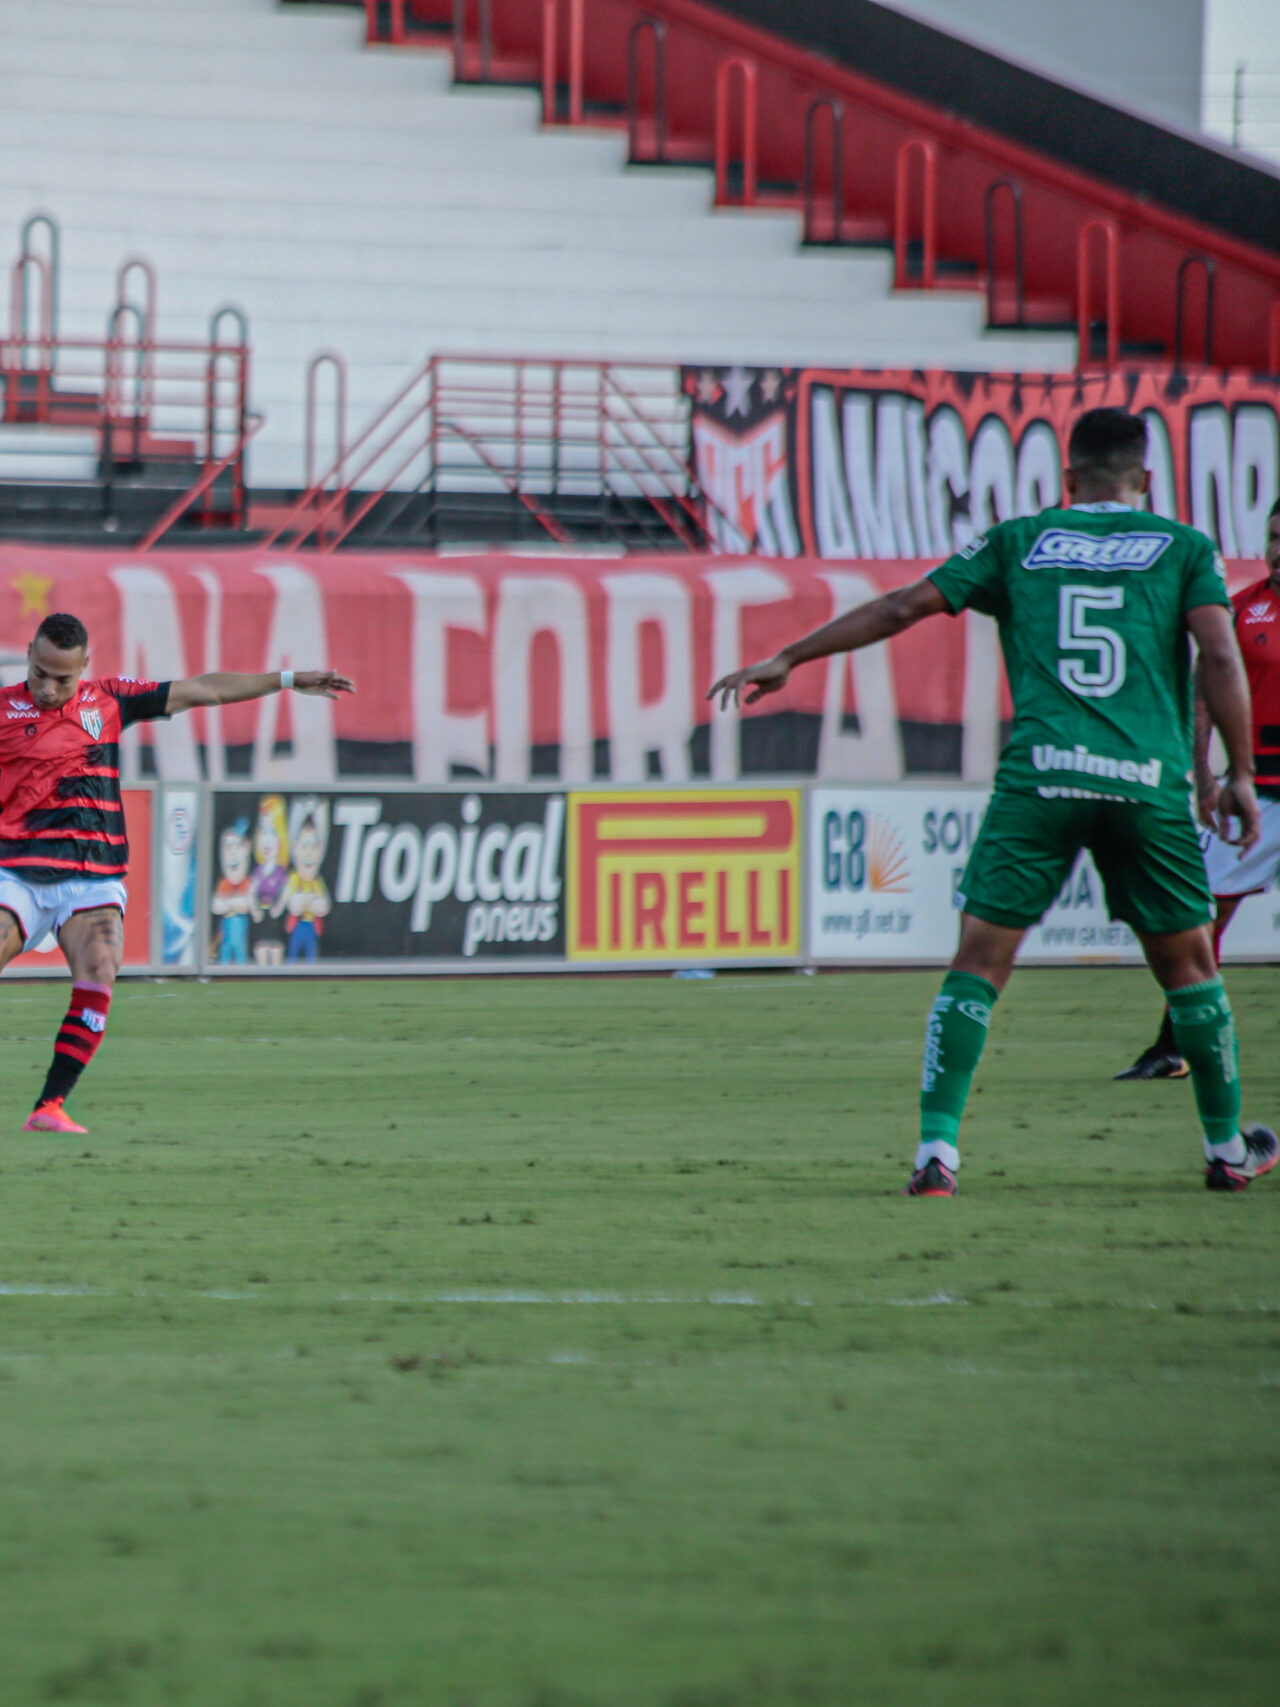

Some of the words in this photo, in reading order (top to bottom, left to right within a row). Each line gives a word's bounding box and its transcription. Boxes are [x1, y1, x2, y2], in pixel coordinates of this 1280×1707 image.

[1058, 584, 1127, 698] 5
[1032, 744, 1163, 788] Unimed
[333, 794, 565, 933] Tropical
[577, 799, 794, 951] PIRELLI
[822, 809, 866, 893] G8
[462, 900, 558, 957] pneus
